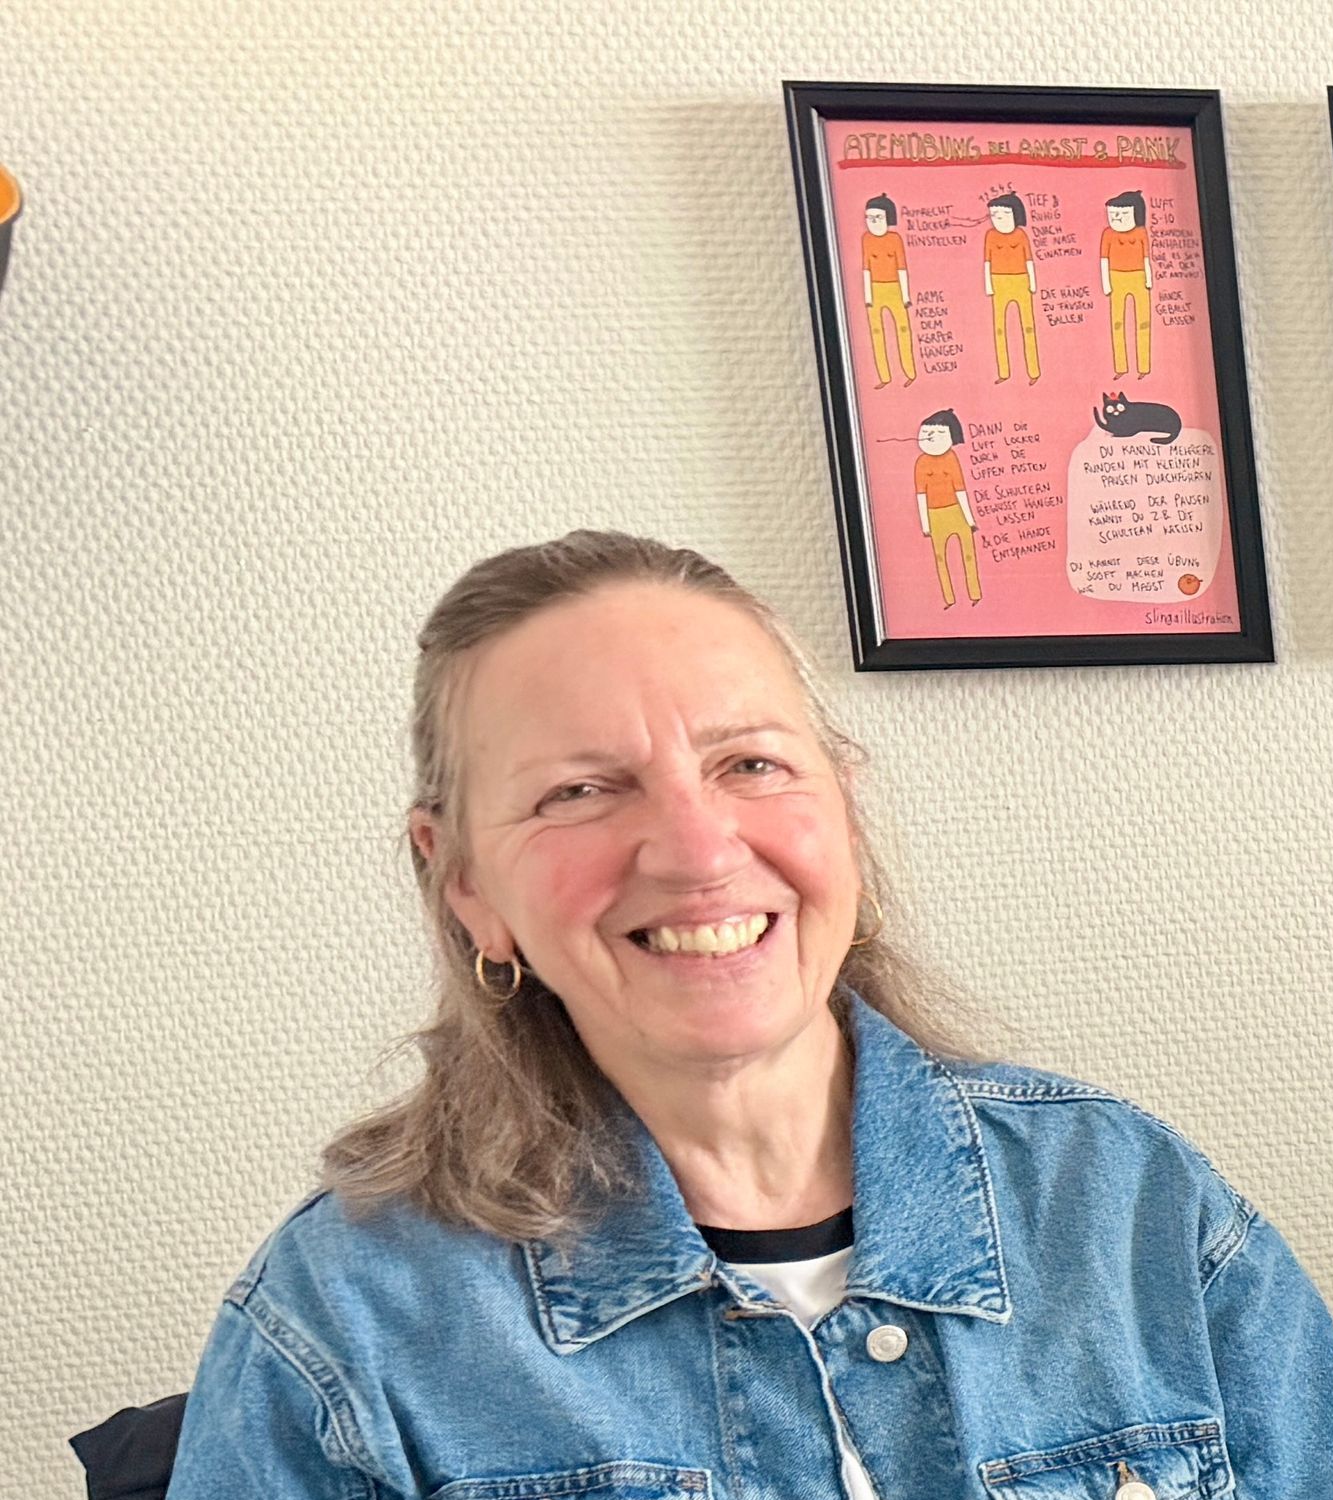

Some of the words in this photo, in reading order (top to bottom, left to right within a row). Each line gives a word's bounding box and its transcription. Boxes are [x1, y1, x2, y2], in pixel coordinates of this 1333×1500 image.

[987, 141, 1009, 155] BEI
[1019, 137, 1088, 160] ANGST
[1093, 140, 1108, 160] &
[1150, 197, 1175, 211] LUFT
[916, 218, 951, 231] LOCKER
[1032, 225, 1062, 237] DURCH
[1053, 233, 1077, 245] NASE
[917, 290, 944, 305] ARME
[916, 306, 948, 318] NEBEN
[1042, 303, 1054, 311] ZU
[1155, 302, 1191, 316] GEBALLT
[921, 319, 943, 330] DEM
[1046, 314, 1083, 327] BALLEN
[1163, 315, 1195, 326] LASSEN
[924, 361, 957, 374] LASSEN
[969, 422, 1002, 438] DANN
[972, 440, 995, 452] LUFT
[1004, 434, 1040, 446] LOCKER
[1100, 446, 1113, 458] DU
[1122, 445, 1161, 456] KANNST
[970, 452, 998, 465] DURCH
[1011, 462, 1047, 475] PUSTEN
[1083, 461, 1125, 474] RUNDEN
[1101, 474, 1138, 488] PAUSEN
[995, 482, 1050, 500] SCHULTERN
[1148, 495, 1167, 507] DER
[1174, 493, 1209, 507] PAUSEN
[996, 511, 1035, 526] LASSEN
[1089, 514, 1122, 526] KANNST
[1132, 512, 1144, 523] DU
[1099, 524, 1152, 544] SCHULTERN
[982, 535, 993, 548] &
[992, 540, 1056, 563] ENTSPANNEN
[1070, 562, 1082, 572] DU
[1089, 558, 1120, 568] KANNST
[1168, 553, 1200, 567] ÜBUNG
[1126, 569, 1163, 580] MACHEN
[1109, 583, 1122, 591] DU
[1132, 580, 1164, 592] MAGST
